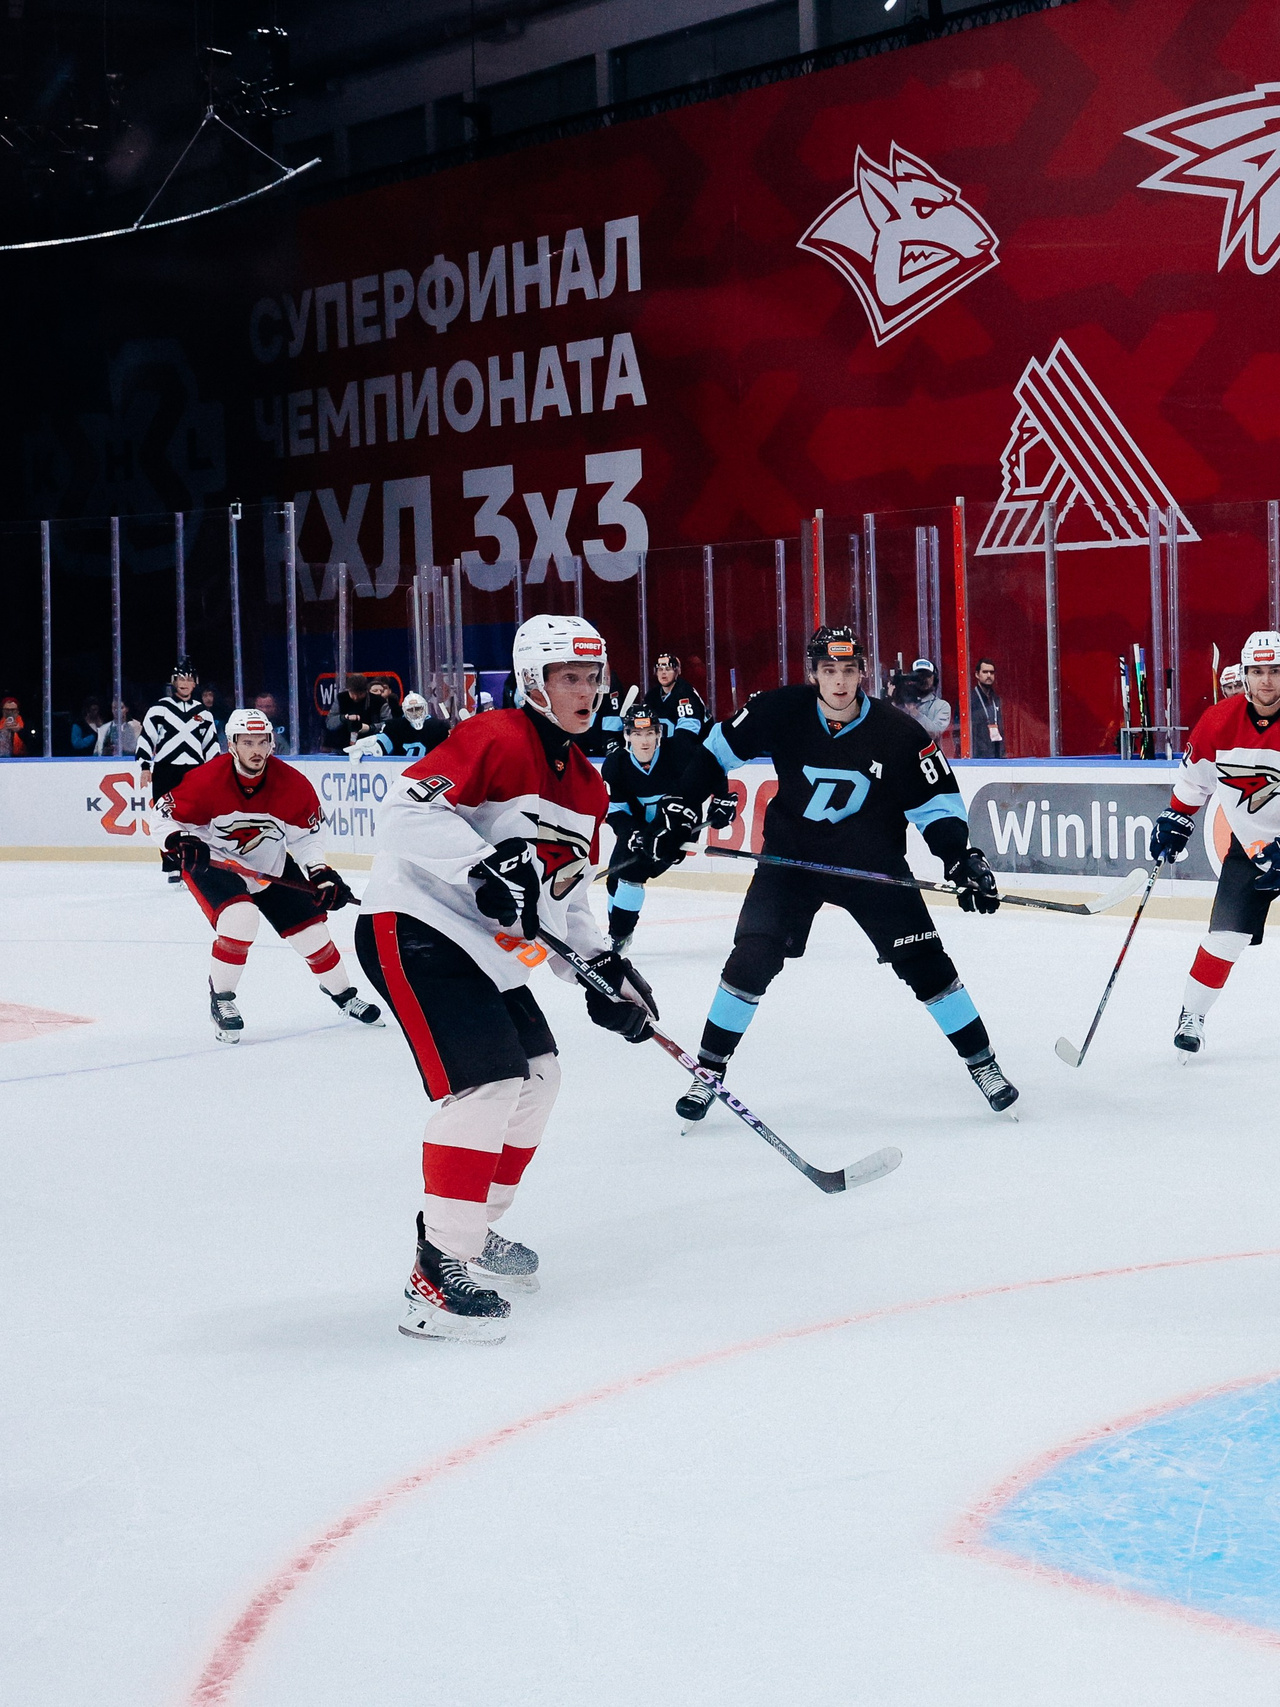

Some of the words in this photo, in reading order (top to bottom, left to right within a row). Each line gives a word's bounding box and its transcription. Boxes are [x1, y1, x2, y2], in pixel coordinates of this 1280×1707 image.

[250, 215, 641, 363] СУПЕРФИНАЛ
[255, 332, 647, 459] ЧЕМПИОНАТА
[263, 475, 435, 605] КХЛ
[574, 642, 602, 650] FONBET
[1258, 638, 1270, 646] 11
[677, 704, 694, 717] 86
[919, 750, 951, 785] 81
[713, 798, 738, 807] CCM
[988, 799, 1188, 862] Winlin
[565, 951, 591, 972] ACE
[586, 968, 614, 994] prime
[677, 1052, 760, 1125] SOYUZ
[410, 1268, 445, 1307] CCM
